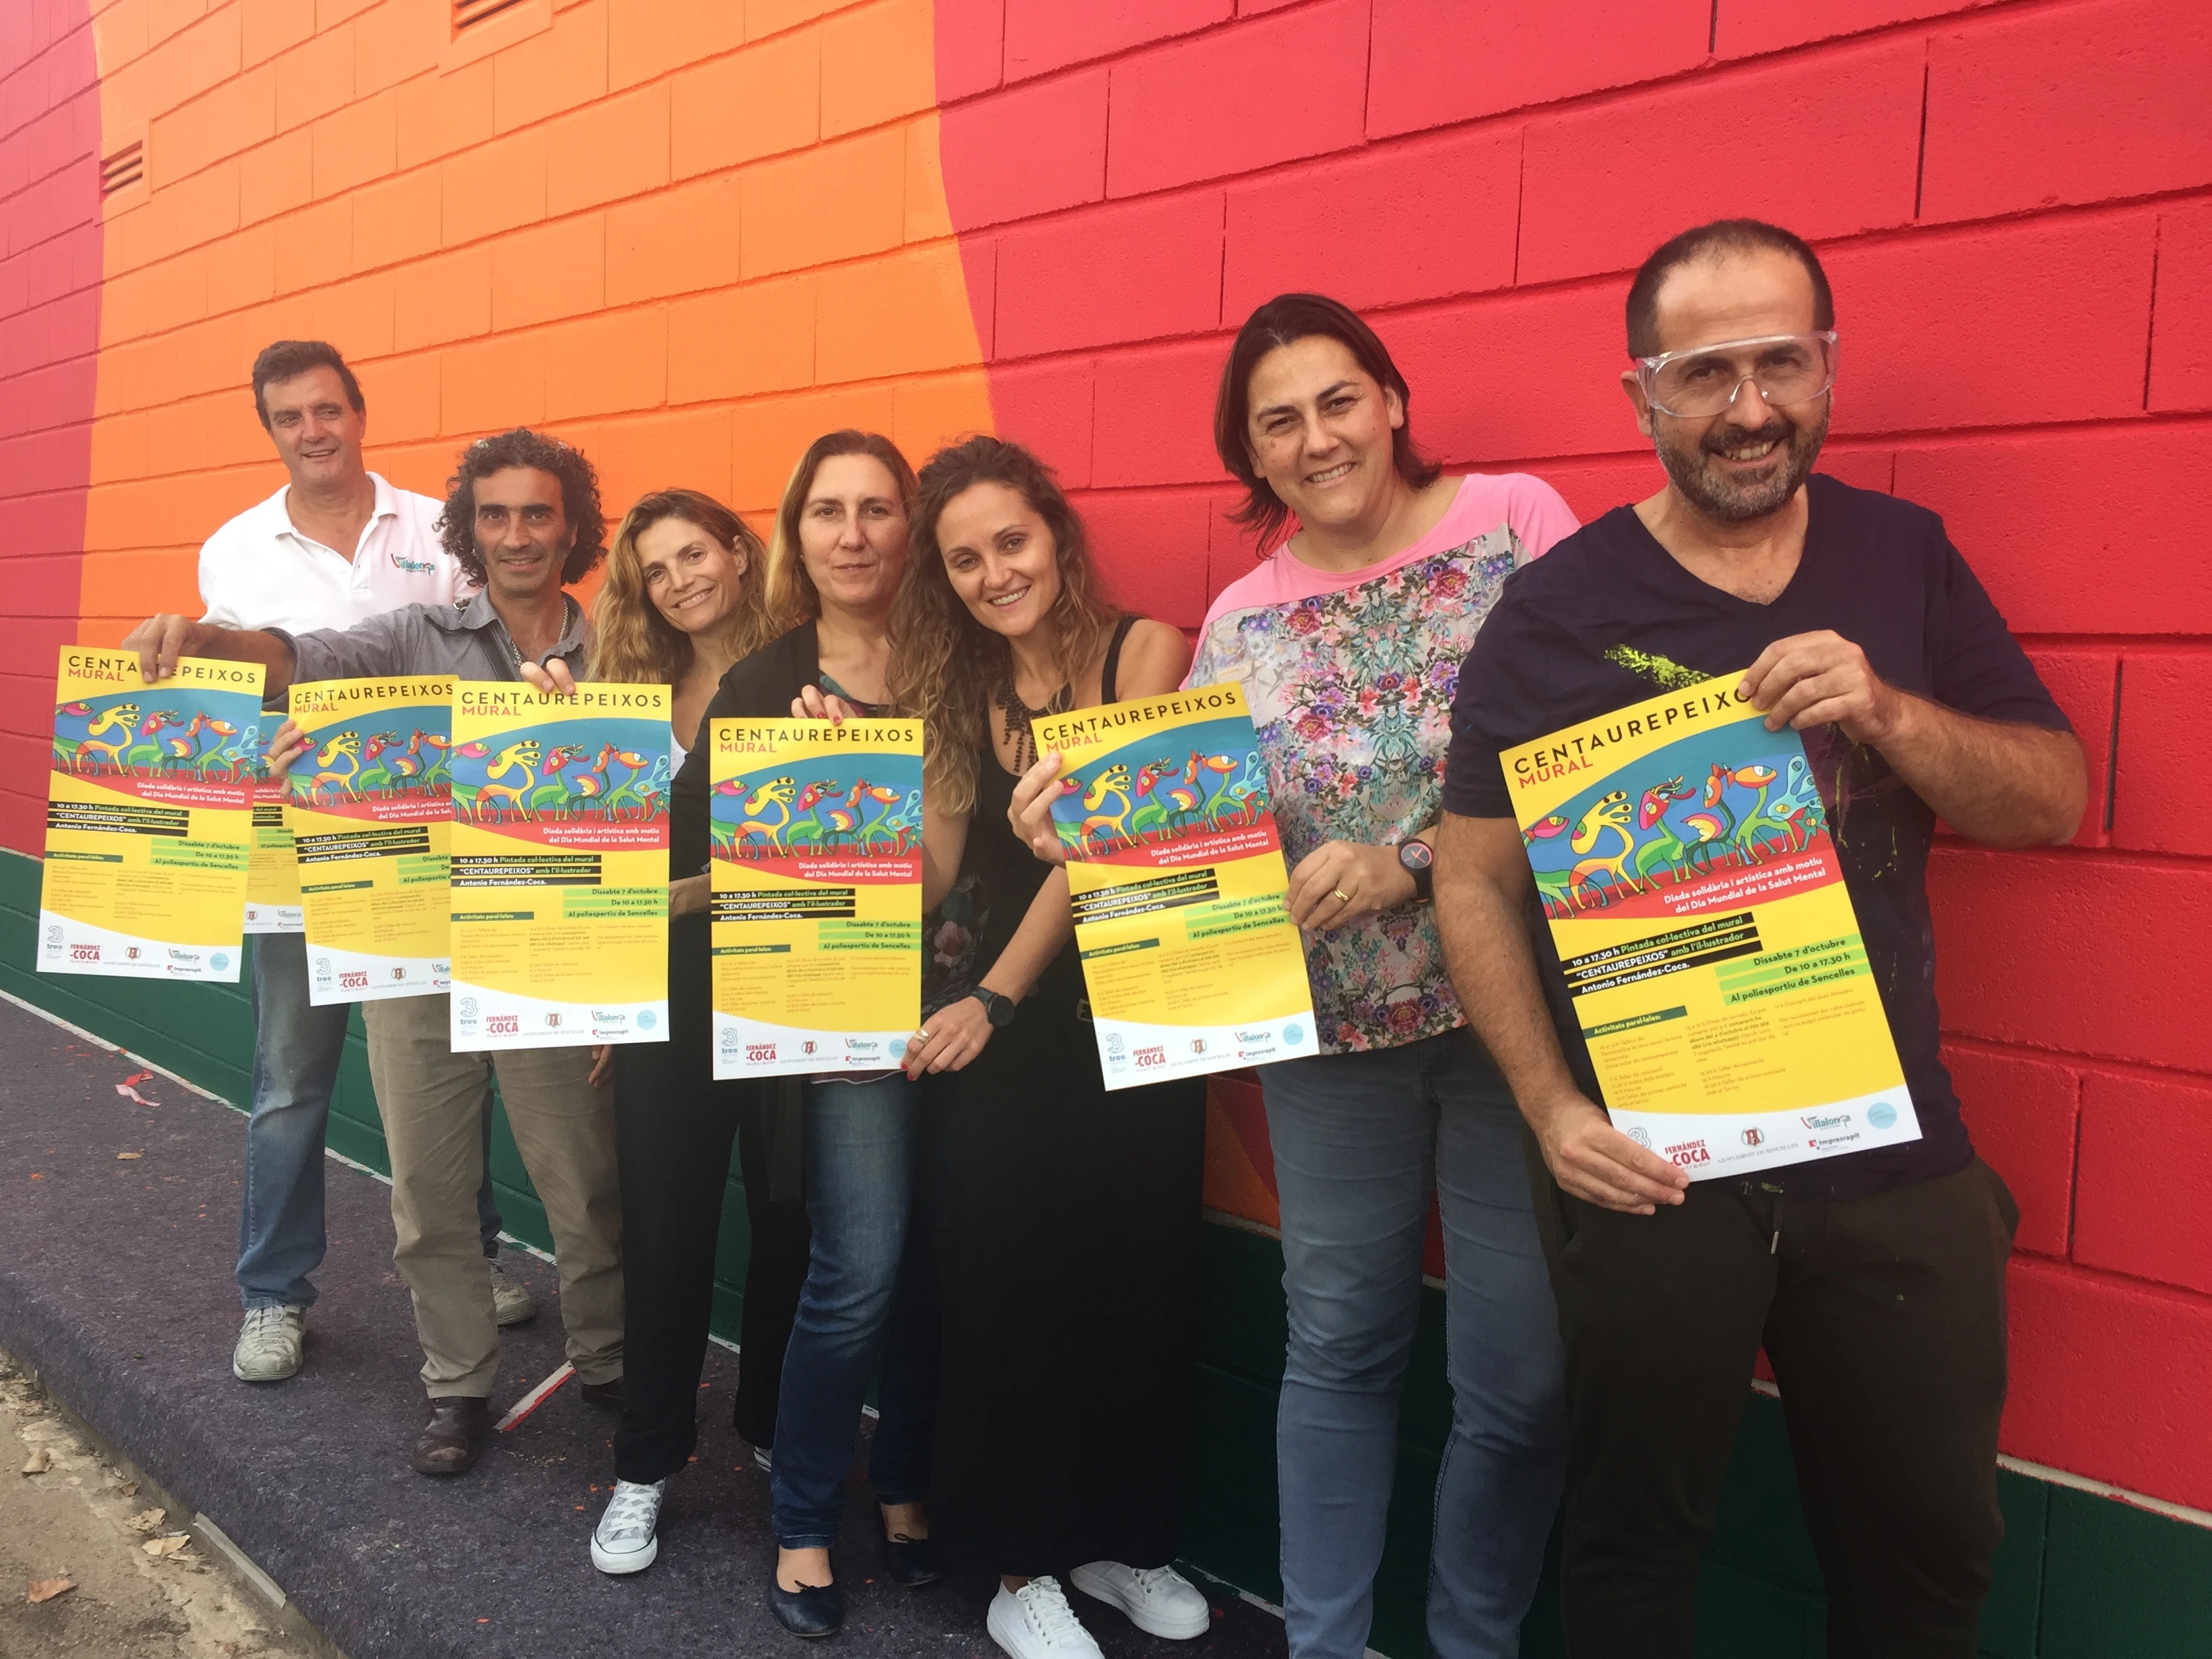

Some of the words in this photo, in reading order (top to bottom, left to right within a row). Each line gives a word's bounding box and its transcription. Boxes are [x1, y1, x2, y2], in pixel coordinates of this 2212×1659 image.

[68, 668, 125, 682] MURAL
[295, 683, 453, 705] CENTAUREPEIXOS
[461, 690, 661, 708] CENTAUREPEIXOS
[294, 702, 339, 714] MURAL
[462, 704, 522, 716] MURAL
[1043, 692, 1235, 740] CENTAUREPEIXOS
[718, 728, 913, 741] CENTAUREPEIXOS
[1515, 688, 1752, 774] CENTAUREPEIXO
[719, 742, 777, 753] MURAL
[1046, 732, 1102, 752] MURAL
[1519, 756, 1594, 789] MURAL
[1150, 846, 1170, 857] Diada
[1170, 842, 1200, 853] solidària
[1203, 837, 1231, 847] artística
[1231, 833, 1246, 842] amb
[1246, 830, 1267, 839] motiu
[1158, 856, 1170, 865] del
[1169, 855, 1182, 863] Dia
[1182, 848, 1209, 860] Mundial
[1209, 847, 1219, 855] de
[1226, 843, 1244, 853] Salut
[1244, 838, 1269, 848] Mental
[459, 878, 488, 886] Antonio
[1092, 889, 1109, 899] 17.30
[1115, 882, 1141, 893] Pintada
[1176, 874, 1187, 882] del
[1187, 869, 1208, 880] mural
[1663, 890, 1690, 904] Diada
[1691, 881, 1729, 897] solidària
[1729, 878, 1734, 887] i
[1735, 870, 1773, 885] artística
[1774, 863, 1794, 876] amb
[1795, 857, 1822, 870] motiu
[1151, 889, 1167, 899] amb
[1675, 901, 1689, 913] del
[1689, 899, 1706, 909] Dia
[1706, 888, 1744, 905] Mundial
[1744, 885, 1757, 895] de
[1757, 882, 1767, 892] la
[1767, 877, 1792, 889] Salut
[1792, 867, 1826, 882] Mental
[1211, 901, 1241, 911] Dissabte
[576, 909, 615, 918] poliesportiu
[720, 913, 747, 921] Antonio
[1081, 912, 1109, 923] Antonio
[1200, 924, 1242, 938] poliesportiu
[1252, 916, 1284, 927] Sencelles
[1571, 958, 1583, 966] 10
[1589, 949, 1613, 964] 17.30
[1612, 947, 1620, 956] h
[1620, 939, 1654, 954] Pintada
[1701, 922, 1716, 933] del
[1717, 915, 1743, 929] mural
[1670, 944, 1689, 956] amb
[1753, 951, 1793, 966] Dissabte
[1794, 949, 1799, 957] 7
[1801, 939, 1845, 954] d'octubre
[1784, 965, 1798, 974] De
[1799, 962, 1810, 970] 10
[1818, 955, 1843, 966] 17.30
[1843, 951, 1851, 960] h
[1581, 979, 1616, 994] Antonio
[1616, 962, 1689, 984] Fernández-Coca.
[1731, 992, 1740, 1002] Al
[1742, 981, 1796, 1001] poliesportiu
[1797, 977, 1809, 987] de
[1810, 968, 1855, 983] Sencelles
[485, 1013, 518, 1023] FERNÁNDEZ
[485, 1021, 519, 1034] -COCA
[1593, 1022, 1625, 1034] Activitats
[745, 1042, 776, 1051] FERNÁNDEZ
[745, 1049, 777, 1061] -COCA
[1818, 1132, 1860, 1145] impresrapit
[1664, 1139, 1705, 1154] FERNÁNDEZ
